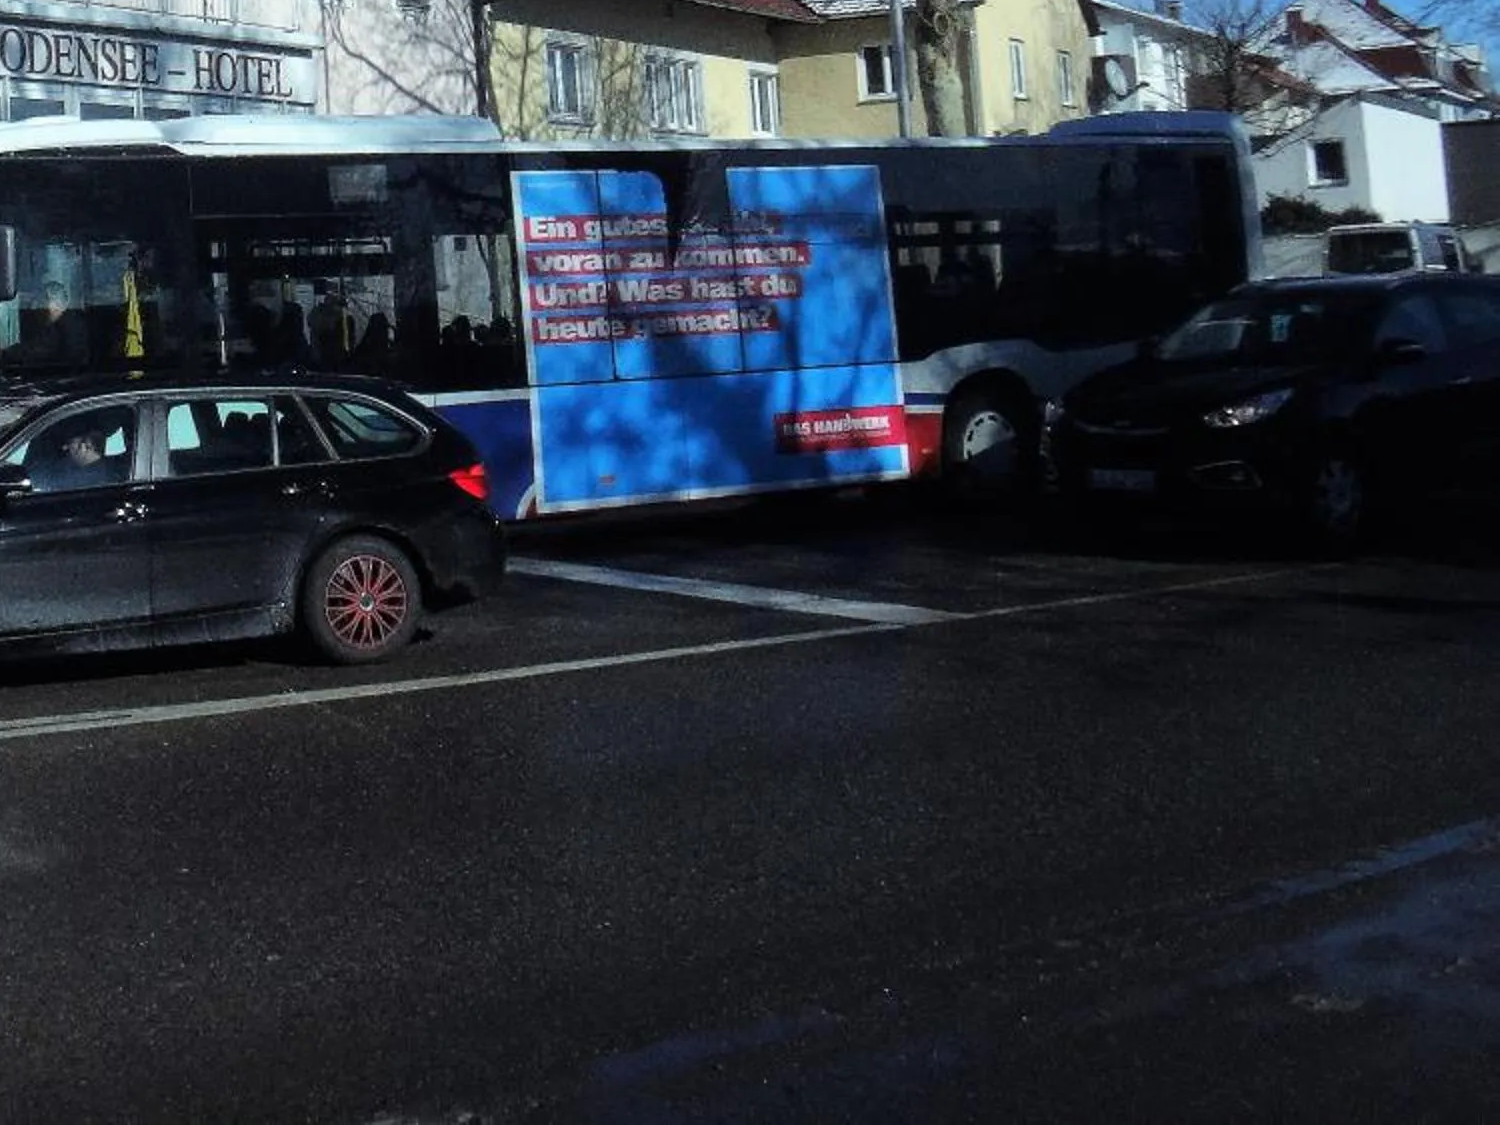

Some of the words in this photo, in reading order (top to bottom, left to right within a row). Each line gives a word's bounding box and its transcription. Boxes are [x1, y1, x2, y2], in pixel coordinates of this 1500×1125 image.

[194, 49, 294, 98] HOTEL
[529, 215, 577, 239] Ein
[583, 216, 668, 242] gutes
[534, 252, 622, 273] voran
[628, 251, 665, 269] zu
[674, 246, 805, 269] kommen.
[535, 280, 611, 307] Und?
[616, 277, 685, 303] Was
[691, 275, 755, 300] hast
[760, 273, 798, 296] du
[537, 316, 626, 341] heute
[632, 305, 773, 340] gemacht?
